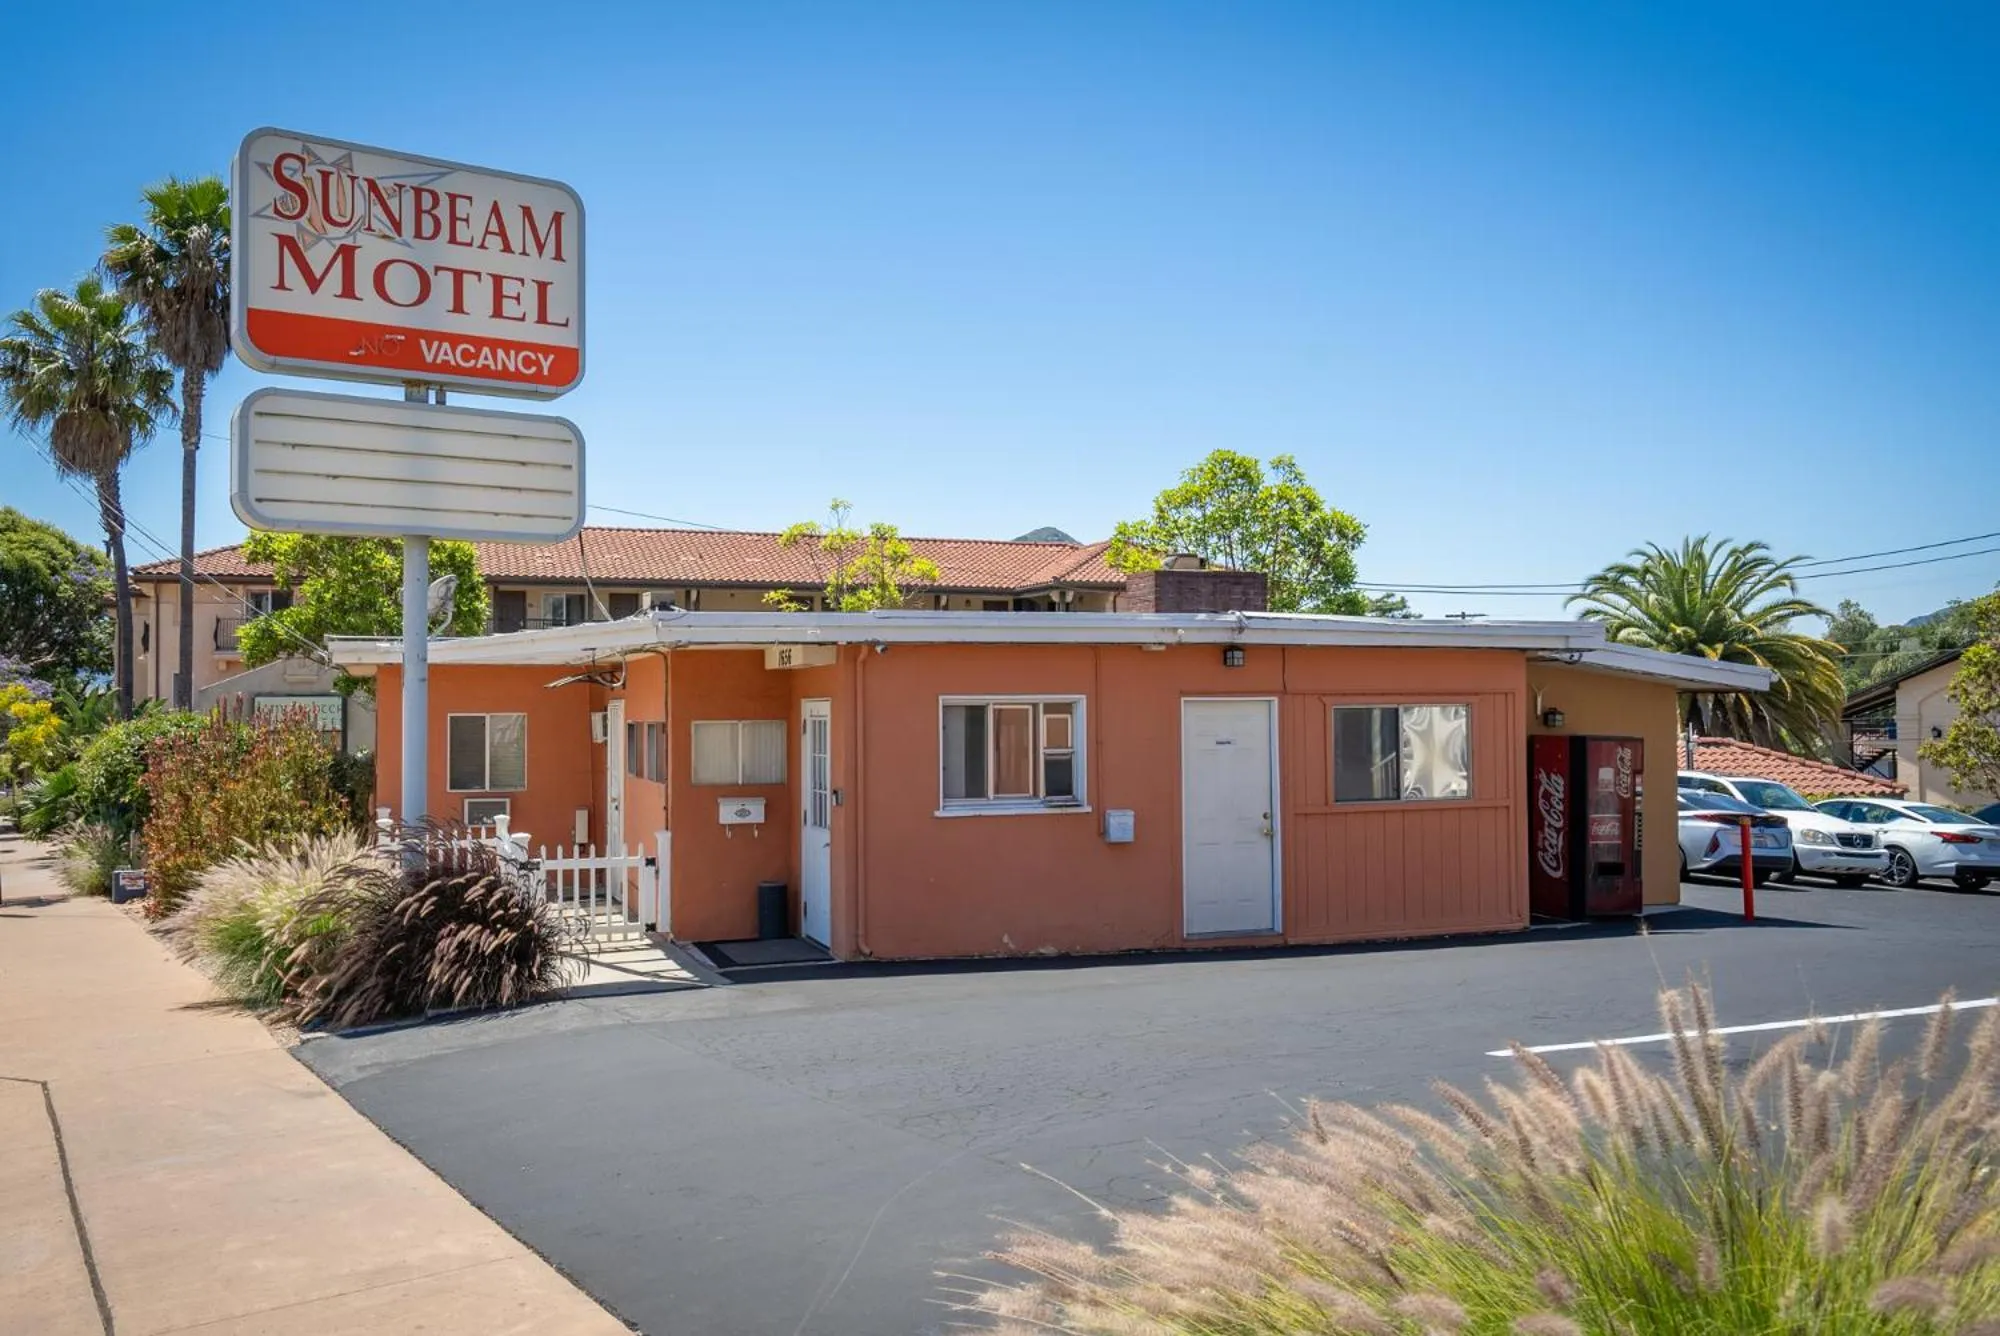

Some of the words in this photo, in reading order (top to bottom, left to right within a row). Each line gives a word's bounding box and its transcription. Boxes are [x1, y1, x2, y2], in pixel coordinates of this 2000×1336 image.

[271, 152, 566, 263] SUNBEAM
[270, 232, 570, 327] MOTEL
[358, 335, 402, 357] NO
[419, 338, 554, 376] VACANCY
